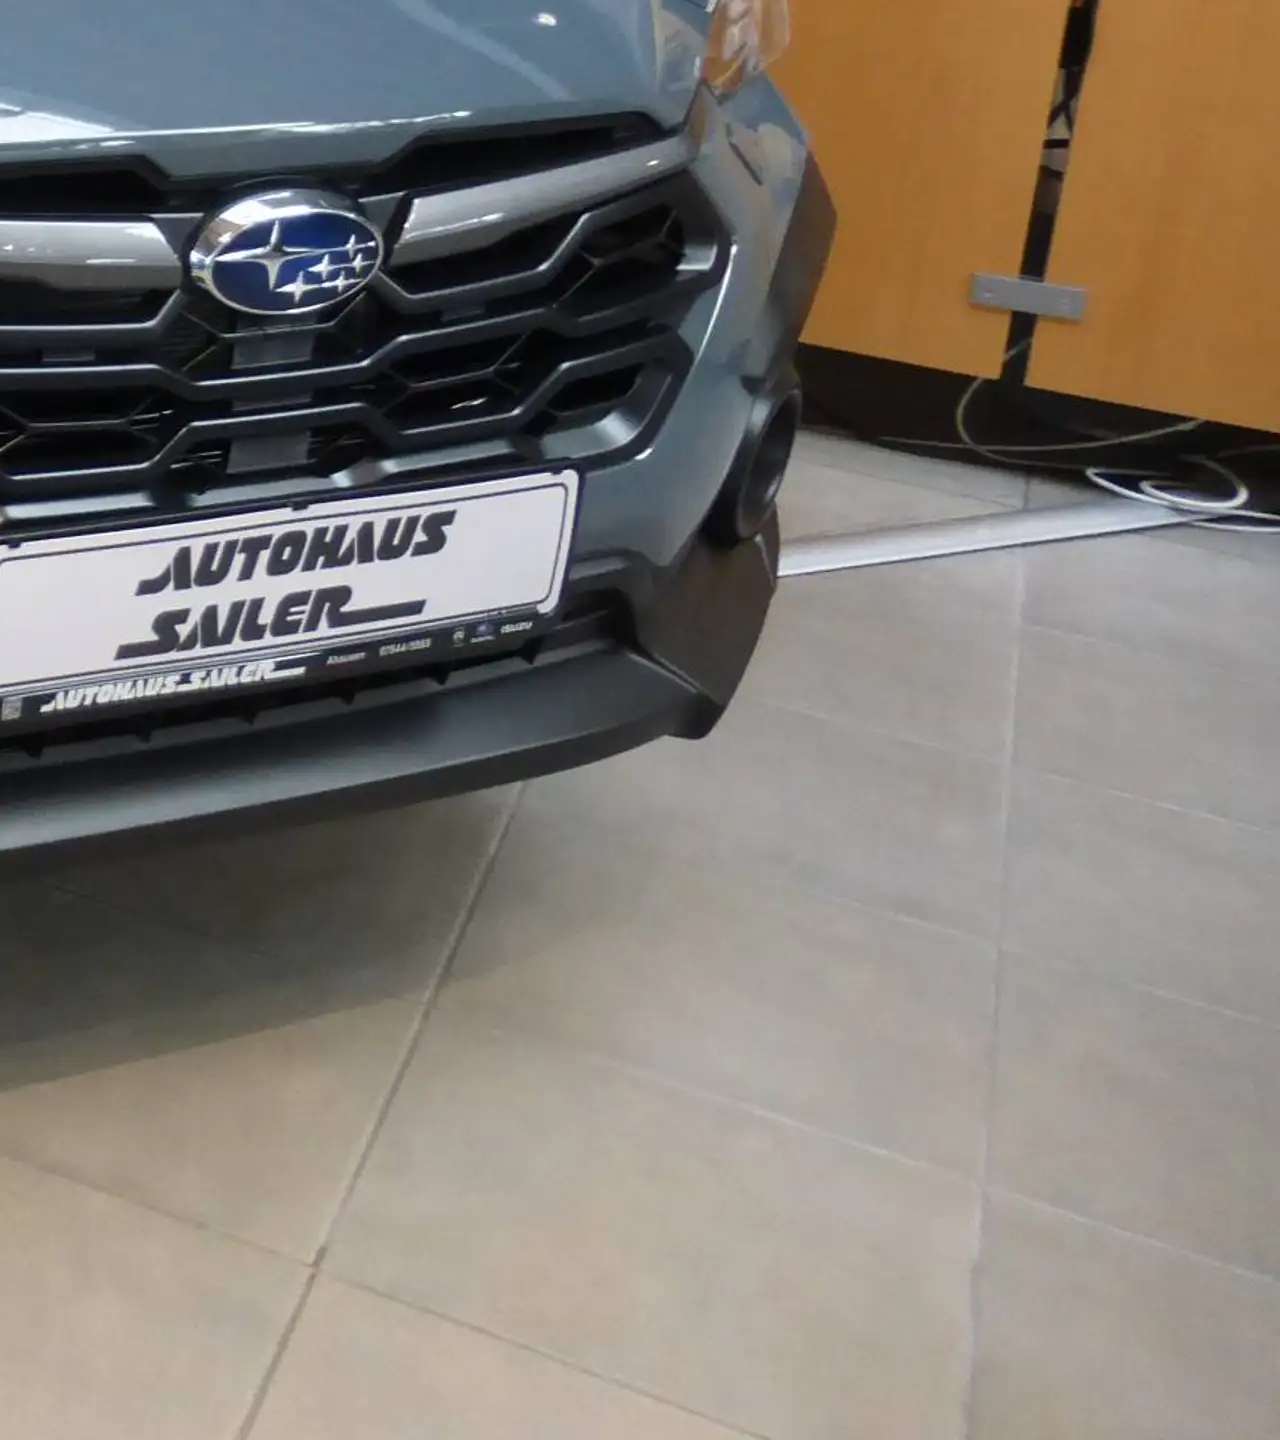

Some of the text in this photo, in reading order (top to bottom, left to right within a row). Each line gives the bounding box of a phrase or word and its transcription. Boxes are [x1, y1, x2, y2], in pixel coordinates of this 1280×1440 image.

[135, 509, 457, 596] AUTOHAUS
[114, 584, 427, 661] SAILER
[40, 674, 181, 714] AUTOHAUS
[176, 659, 307, 693] SAILER
